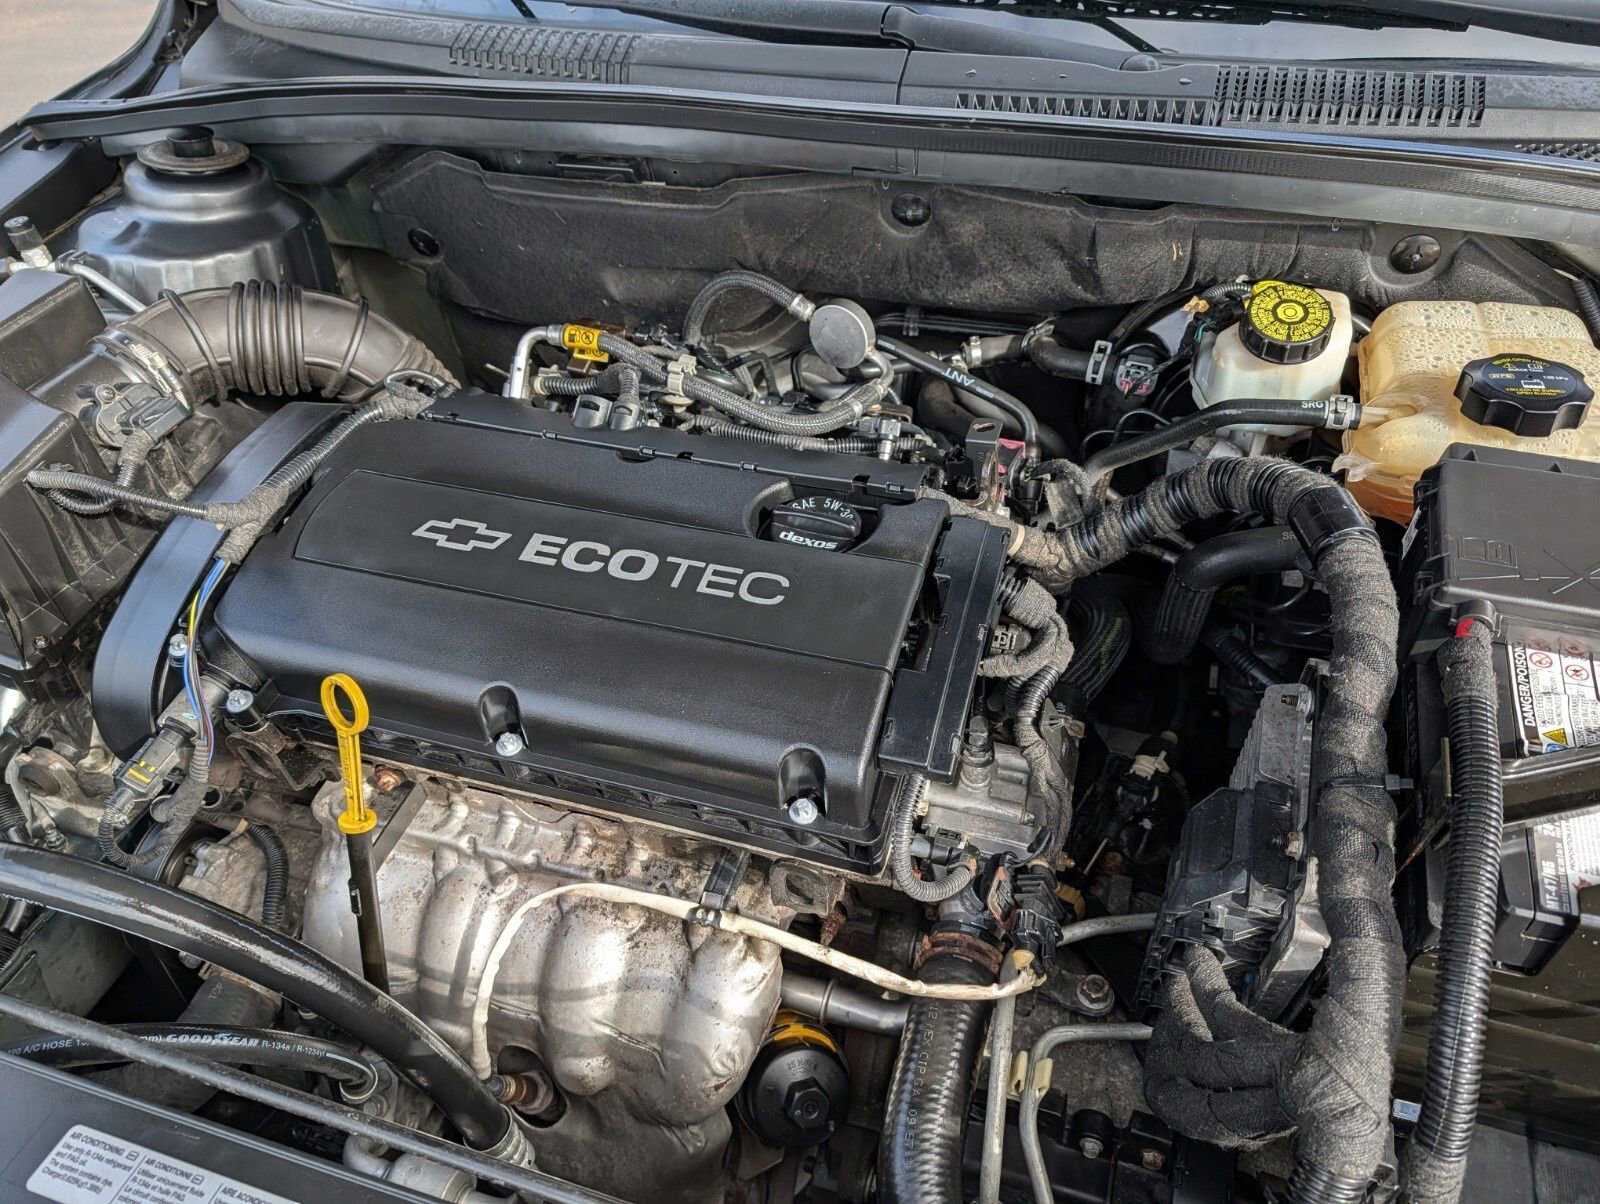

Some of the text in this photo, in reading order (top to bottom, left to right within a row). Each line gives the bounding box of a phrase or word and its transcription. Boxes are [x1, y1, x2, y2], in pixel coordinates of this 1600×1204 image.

[941, 367, 976, 387] ANT
[1301, 400, 1324, 408] SRG
[779, 531, 838, 550] dexos
[518, 532, 790, 605] ECOTEC
[23, 1043, 40, 1054] A/C
[42, 1039, 73, 1050] HOSE
[166, 1031, 259, 1047] GOODYEAR
[261, 1040, 291, 1051] R-134a
[70, 1132, 125, 1156] AIR CONDITIONING
[59, 1163, 79, 1173] system
[78, 1170, 101, 1183] contains
[104, 1158, 133, 1173] refrigerant
